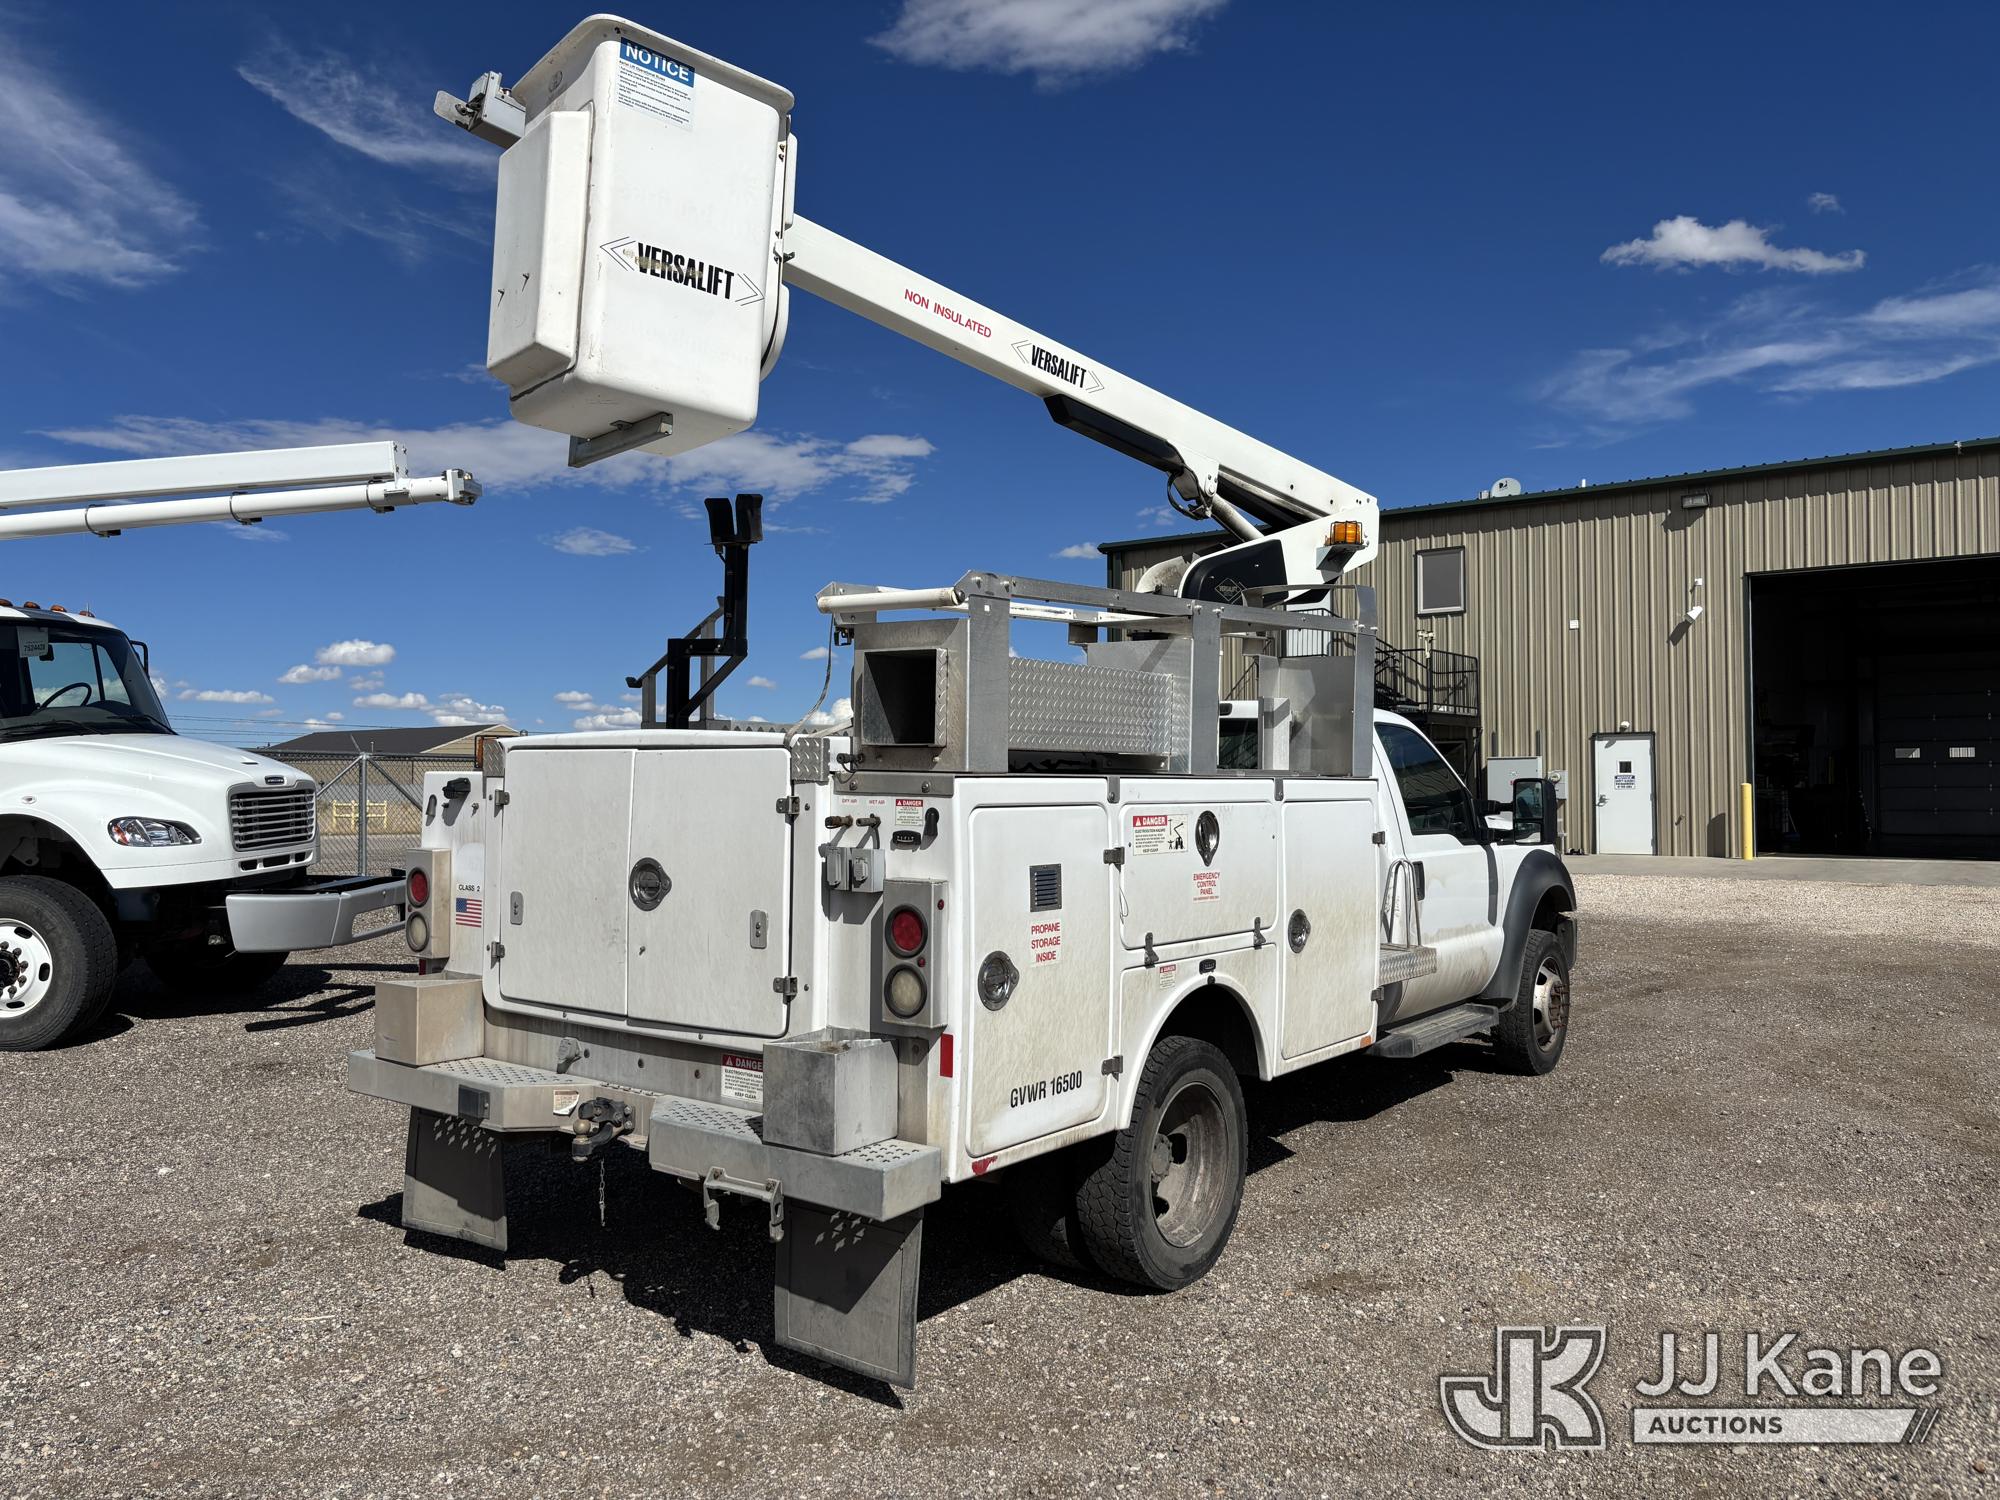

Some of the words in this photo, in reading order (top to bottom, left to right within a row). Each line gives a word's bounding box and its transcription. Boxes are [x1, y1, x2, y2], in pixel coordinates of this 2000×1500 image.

[626, 43, 689, 82] NOTICE
[638, 242, 734, 300] VERSALIFT
[904, 288, 929, 309] NON
[934, 302, 992, 338] INSULATED
[1031, 344, 1087, 388] VERSALIFT
[1142, 816, 1166, 825] DANGER
[1193, 872, 1220, 880] EMERGENCY
[1197, 880, 1216, 888] CONTROL
[1031, 922, 1060, 935] PROPANE
[1031, 936, 1060, 949] STORAGE
[1036, 951, 1056, 963] INSIDE
[735, 1057, 763, 1070] DANGE
[1010, 1081, 1046, 1108] GVWR
[1050, 1070, 1082, 1096] 16500
